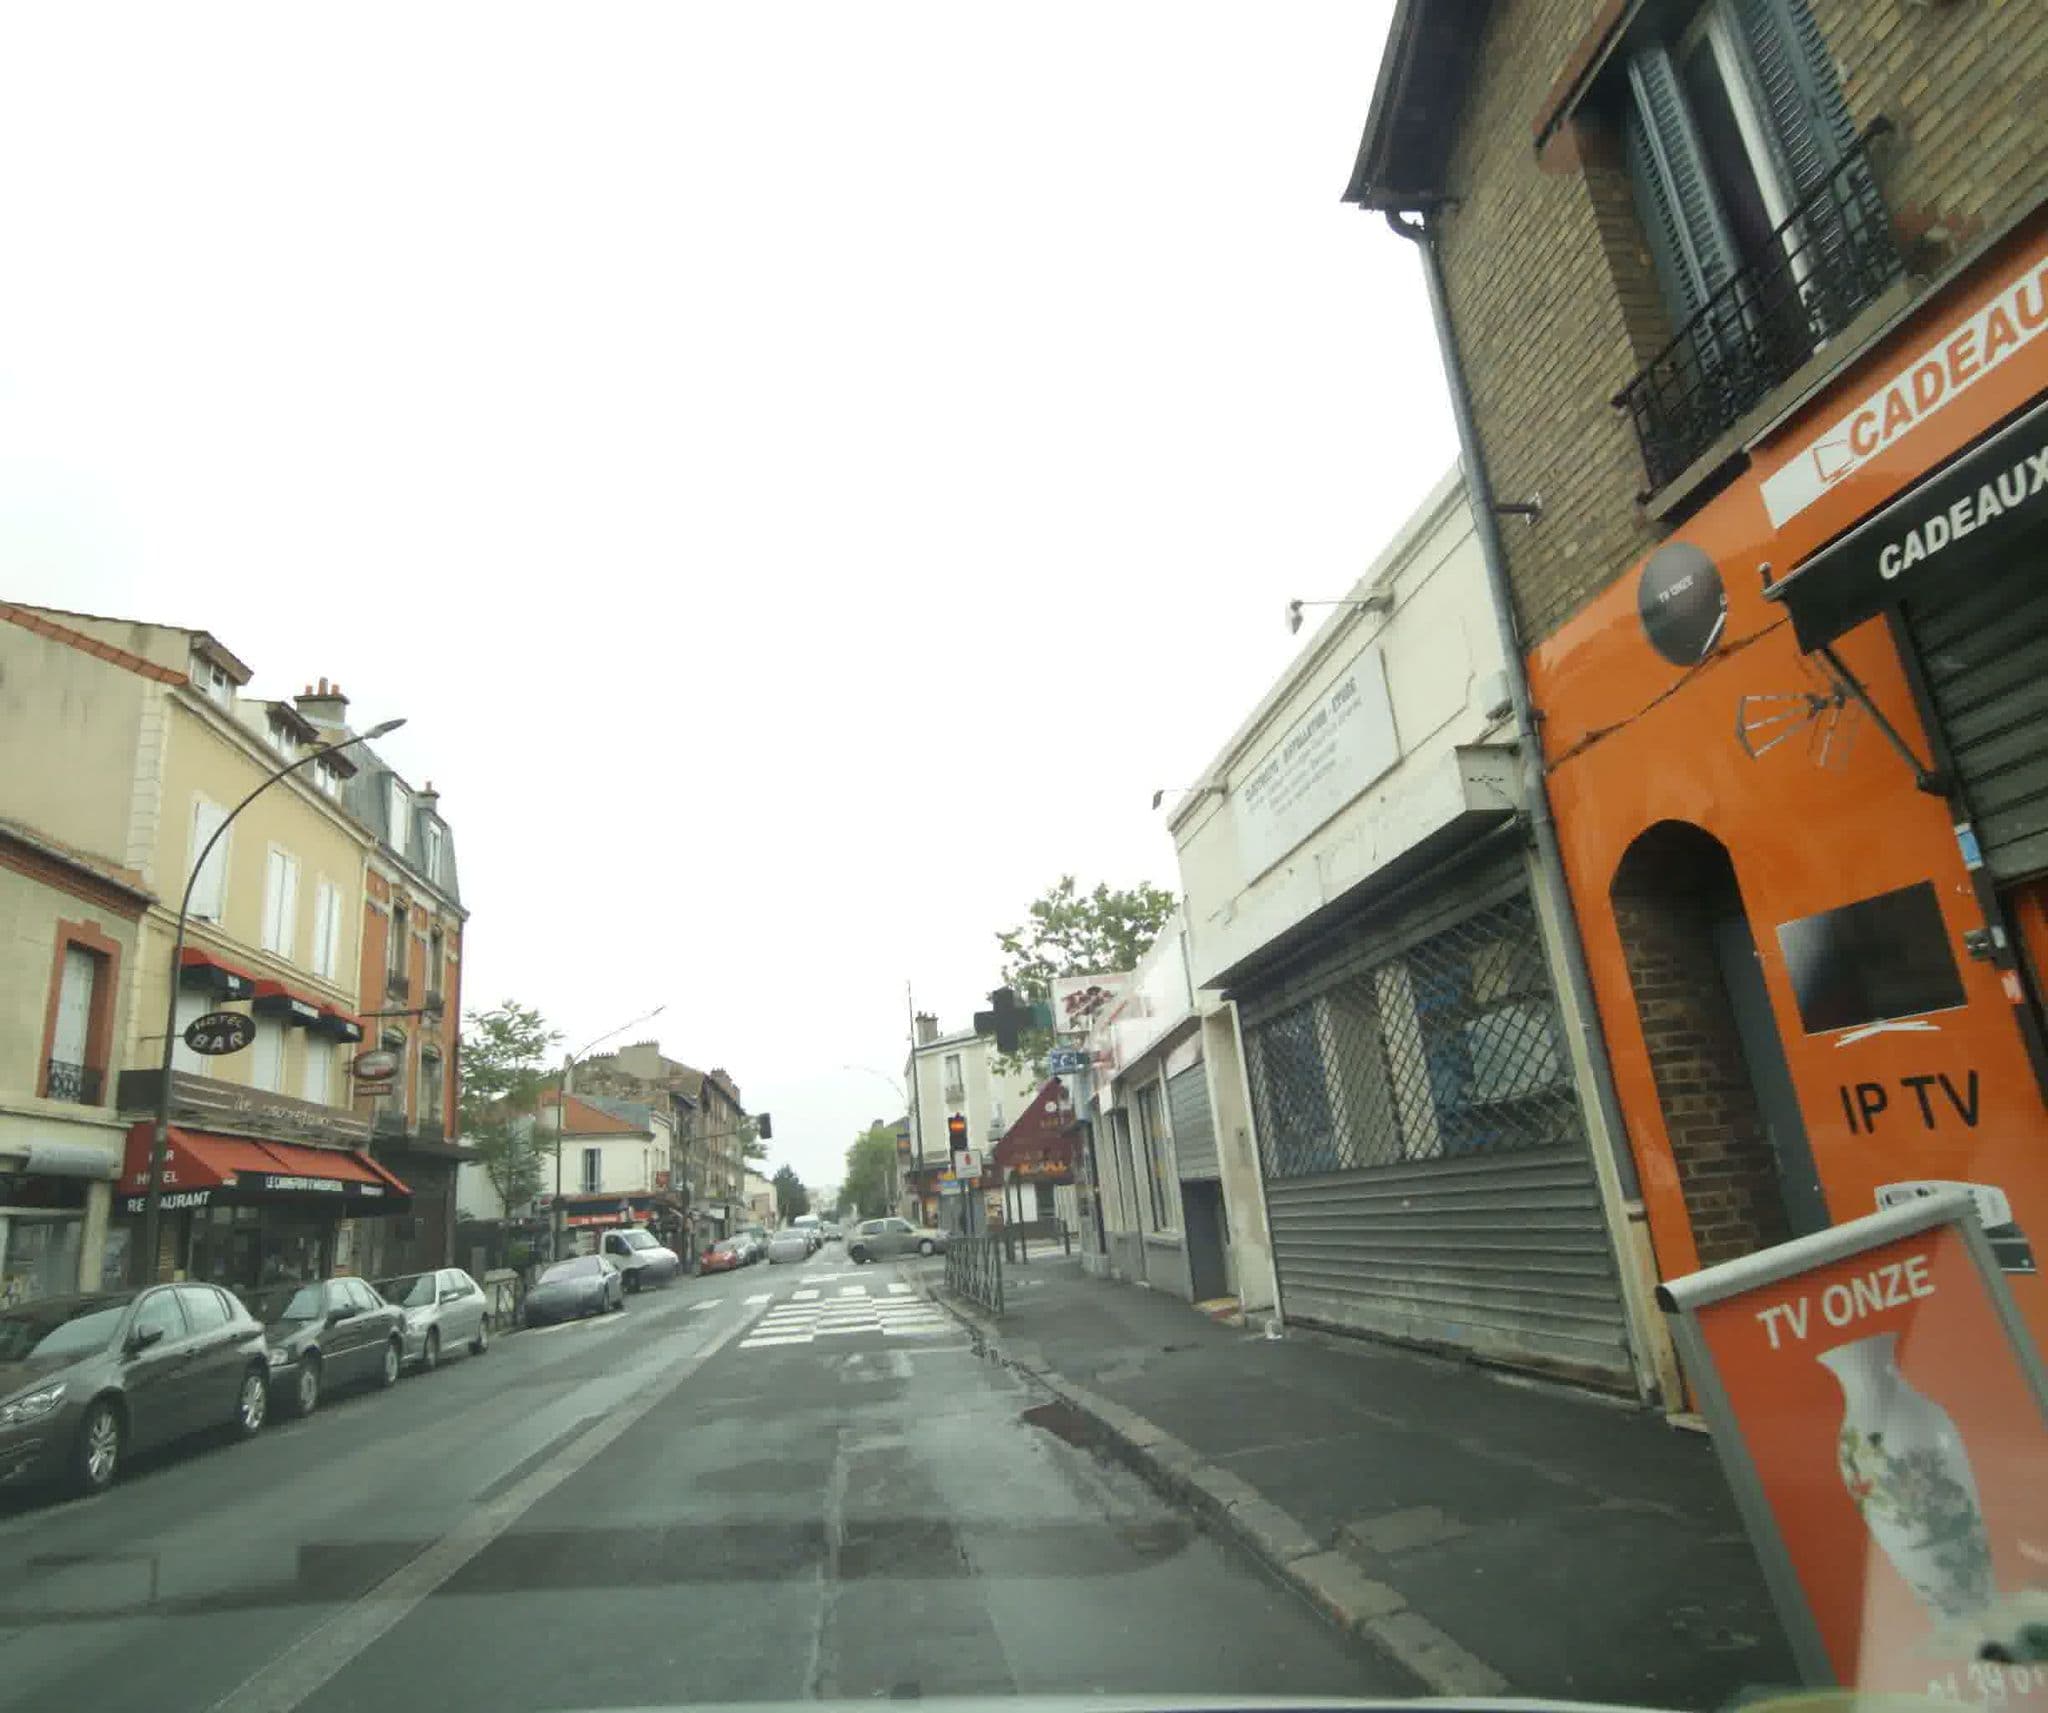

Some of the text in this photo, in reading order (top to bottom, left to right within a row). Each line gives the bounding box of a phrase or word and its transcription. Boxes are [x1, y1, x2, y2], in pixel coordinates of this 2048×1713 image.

[1879, 446, 2048, 580] CADEAUX
[190, 1031, 244, 1051] BAR
[1840, 1069, 1979, 1135] IP TV
[1755, 1254, 1936, 1350] TV ONZE
